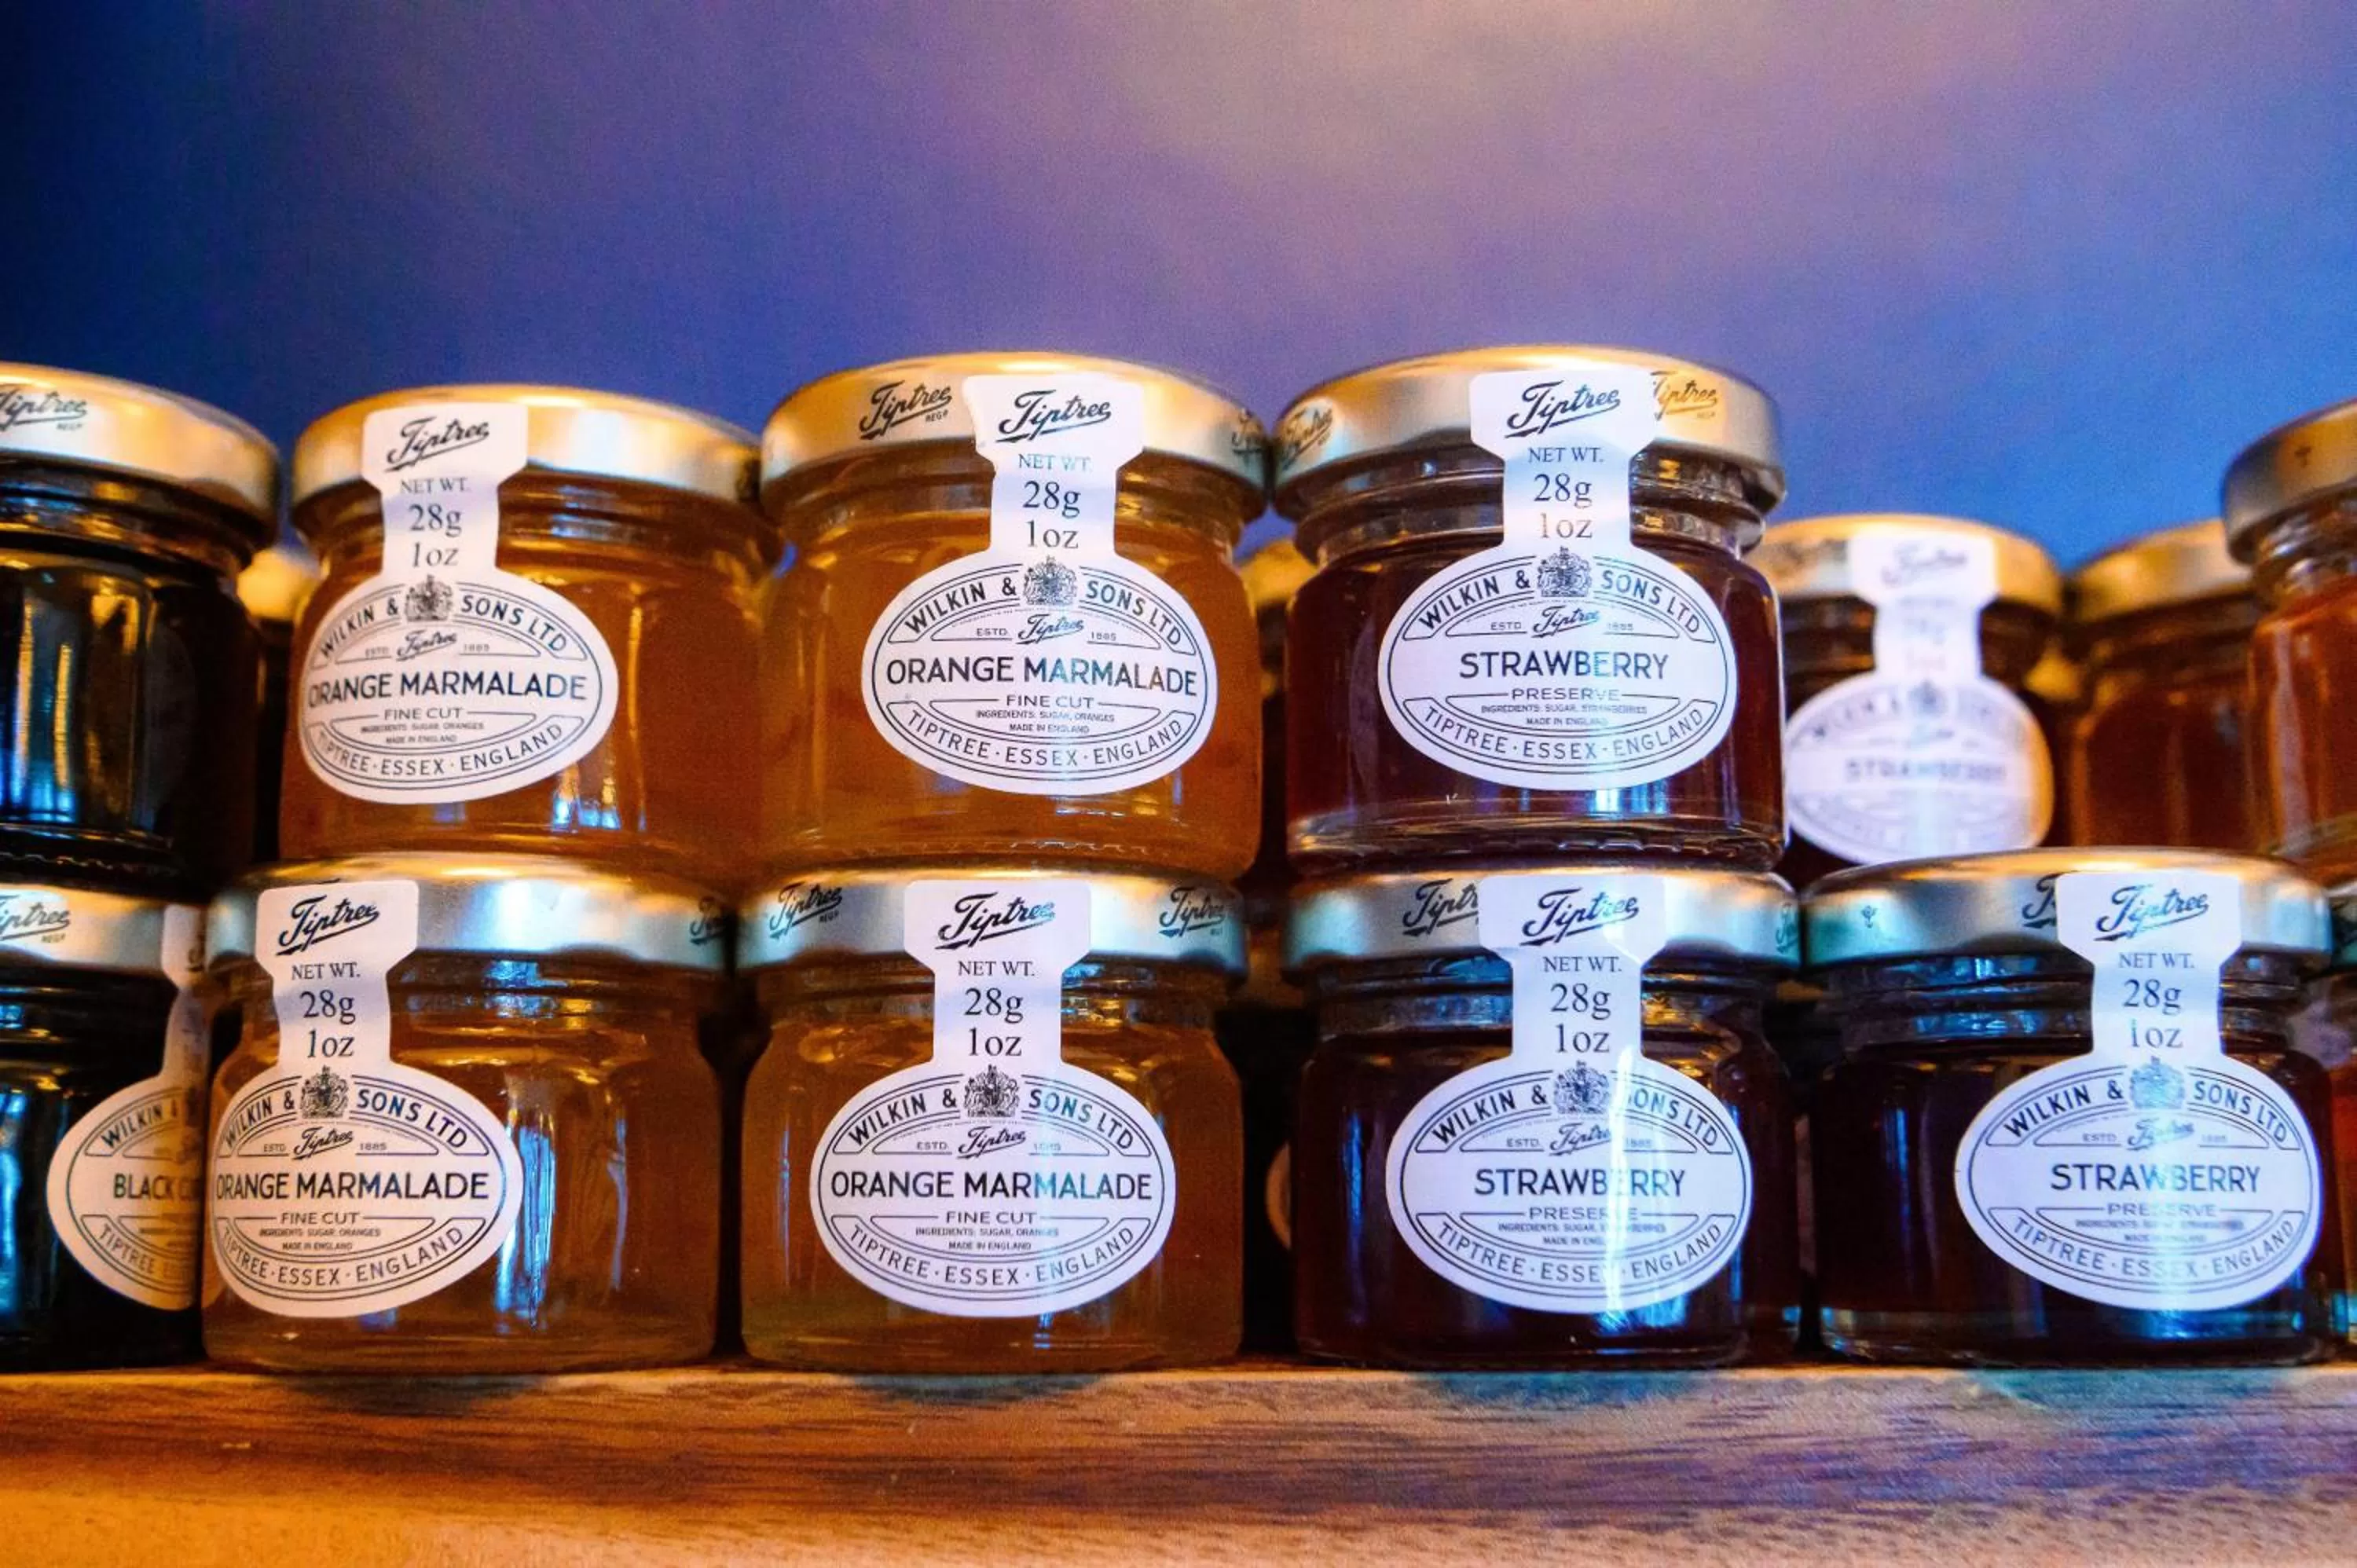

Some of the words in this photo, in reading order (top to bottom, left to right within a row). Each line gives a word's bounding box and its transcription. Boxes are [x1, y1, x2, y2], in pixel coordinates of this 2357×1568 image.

[859, 380, 953, 440] Tiptree
[995, 390, 1113, 443] Tiptree
[1505, 379, 1622, 438] Tiptree
[384, 416, 490, 472] Tiptree
[1017, 453, 1056, 470] NET
[1527, 445, 1567, 463] NET
[1571, 445, 1605, 463] WT.
[400, 478, 433, 495] NET
[438, 477, 471, 494] WT.
[1022, 480, 1081, 519] 28g
[1534, 473, 1594, 509] 28g
[409, 504, 462, 537] 28g
[1025, 519, 1079, 549] 1oz
[1540, 512, 1594, 540] 1oz
[412, 542, 458, 568] 1oz
[904, 581, 987, 636] WILKIN
[1002, 577, 1017, 597] &
[1086, 580, 1146, 616] SONS
[1148, 610, 1182, 647] LTD
[1419, 574, 1501, 631] WILKIN
[1516, 569, 1530, 589] &
[1601, 573, 1662, 606] SONS
[1666, 597, 1700, 635] LTD
[320, 606, 375, 659] WILKIN
[387, 597, 399, 616] &
[460, 595, 522, 625] SONS
[529, 616, 567, 652] LTD
[1016, 613, 1085, 645] Tiptree
[1531, 605, 1600, 639] Tiptree
[886, 657, 1014, 684] ORANGE
[1024, 657, 1197, 697] MARMALADE
[1459, 650, 1670, 680] STRAWBERRY
[308, 673, 393, 709] ORANGE
[399, 672, 588, 701] MARMALADE
[1006, 694, 1050, 708] FINE
[1055, 696, 1094, 709] CUT
[1511, 687, 1621, 701] PRESERVE
[384, 708, 421, 720] FINE
[426, 707, 463, 719] CUT
[318, 731, 370, 773] TIPTREE
[380, 758, 445, 776] ESSEX
[460, 723, 564, 772] ENGLAND
[907, 709, 990, 760] TIPTREE
[1004, 746, 1079, 768] ESSEX
[1093, 718, 1184, 766] ENGLAND
[1424, 706, 1508, 754] TIPTREE
[1524, 740, 1598, 760] ESSEX
[1614, 709, 1703, 757] ENGLAND
[0, 895, 71, 940] iptree
[276, 894, 380, 956] Tiptree
[769, 881, 843, 940] Tiptree
[934, 891, 1056, 951] Tiptree
[1402, 878, 1479, 936] Tiptr
[1519, 888, 1640, 947] Tiptree
[2095, 884, 2209, 942] Tiptree
[291, 963, 326, 980] NET
[328, 962, 361, 979] WT.
[957, 962, 996, 977] NET
[1002, 962, 1036, 977] WT.
[1543, 955, 1582, 973] NET
[1587, 955, 1622, 973] WT.
[2118, 952, 2157, 969] NET
[2161, 951, 2194, 969] WT.
[300, 990, 356, 1024] 28g
[965, 987, 1024, 1024] 28g
[1550, 983, 1611, 1020] 28g
[2122, 979, 2182, 1016] 28g
[307, 1028, 354, 1058] 1oz
[969, 1027, 1023, 1057] 1oz
[1557, 1024, 1611, 1053] 1oz
[101, 1105, 162, 1149] WILKIN
[224, 1099, 273, 1149] WILKIN
[284, 1090, 295, 1109] &
[357, 1089, 420, 1121] SONS
[425, 1110, 468, 1149] LTD
[849, 1092, 927, 1146] WILKIN
[943, 1088, 957, 1108] &
[1028, 1089, 1092, 1123] SONS
[1098, 1112, 1134, 1151] LTD
[1431, 1089, 1517, 1145] WILKIN
[1531, 1083, 1547, 1105] &
[1623, 1087, 1680, 1121] ONS
[1684, 1109, 1719, 1147] LTD
[2004, 1084, 2091, 1138] WILKIN
[2106, 1079, 2124, 1100] &
[2194, 1080, 2251, 1114] SONS
[2256, 1104, 2288, 1143] LTD
[292, 1126, 354, 1160] Tiptree
[957, 1125, 1027, 1160] Tiptree
[216, 1173, 290, 1200] ORANGE
[295, 1172, 489, 1200] MARMALADE
[830, 1171, 955, 1199] ORANGE
[963, 1171, 1153, 1200] MARMALADE
[1474, 1168, 1686, 1197] STRAWBRRY
[2050, 1163, 2260, 1192] STRAWBERRY
[280, 1212, 317, 1225] FINE
[322, 1211, 360, 1225] CUT
[946, 1211, 991, 1225] FINE
[995, 1211, 1037, 1225] CUT
[1529, 1207, 1638, 1221] PRESERE
[99, 1223, 155, 1274] TIPTREE
[222, 1226, 268, 1279] TIPTREE
[277, 1266, 341, 1286] ESSEX
[357, 1226, 464, 1282] ENGLAND
[849, 1224, 929, 1280] TIPTREE
[944, 1266, 1019, 1287] ESSEX
[1036, 1226, 1135, 1284] ENGLAND
[1438, 1222, 1526, 1277] TIPTREE
[1632, 1223, 1723, 1279] ENGLAND
[2012, 1216, 2106, 1272] TIPTREE
[2123, 1258, 2199, 1280] ESSEX
[2213, 1220, 2294, 1276] ENGLAND
